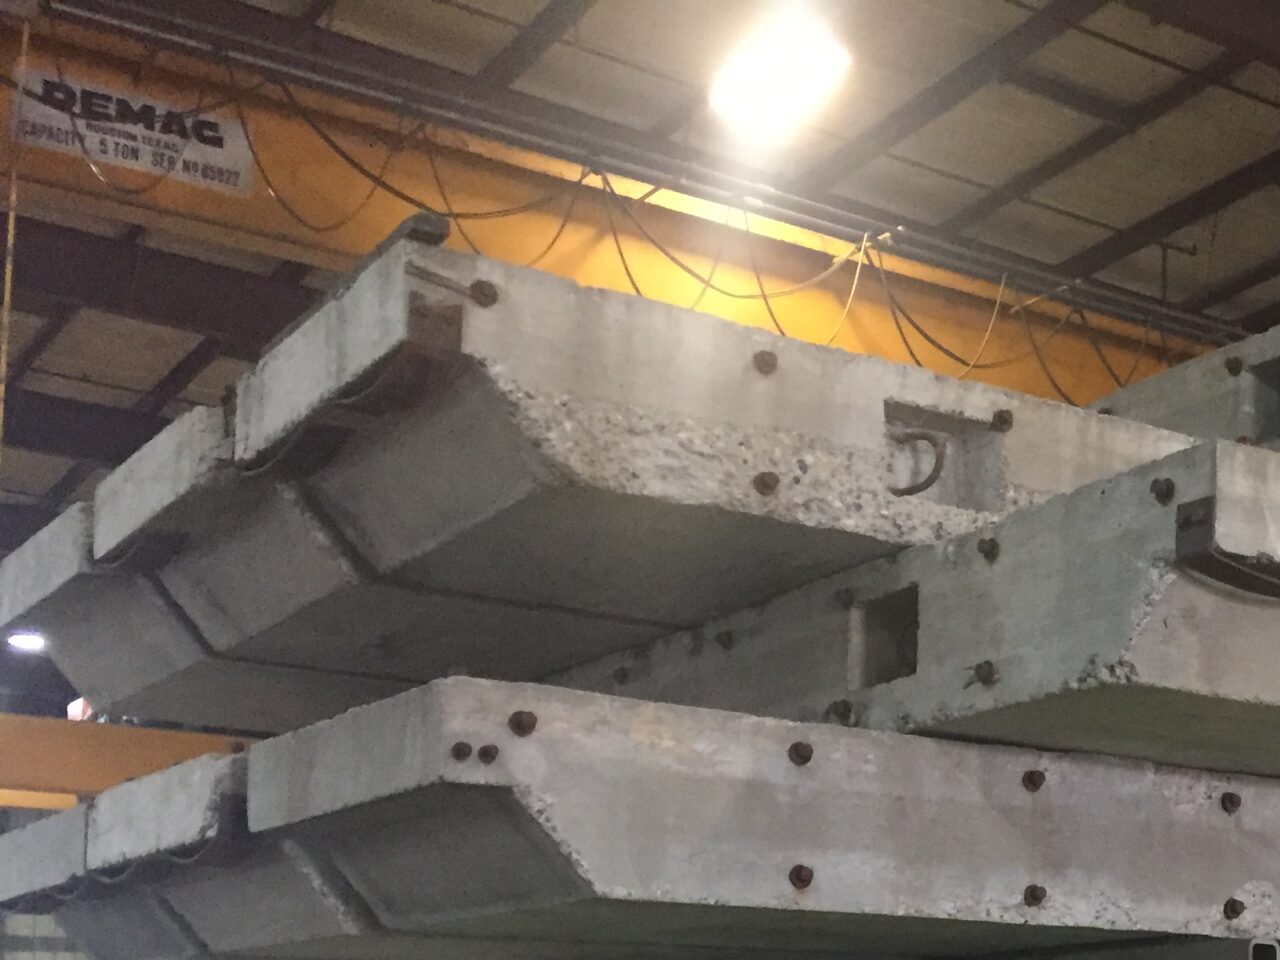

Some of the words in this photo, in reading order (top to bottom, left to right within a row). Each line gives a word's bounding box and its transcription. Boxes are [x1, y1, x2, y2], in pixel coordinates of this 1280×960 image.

[17, 119, 86, 148] CAPACITY
[99, 137, 108, 155] 5
[114, 141, 140, 161] TON
[42, 79, 224, 149] DEMAG
